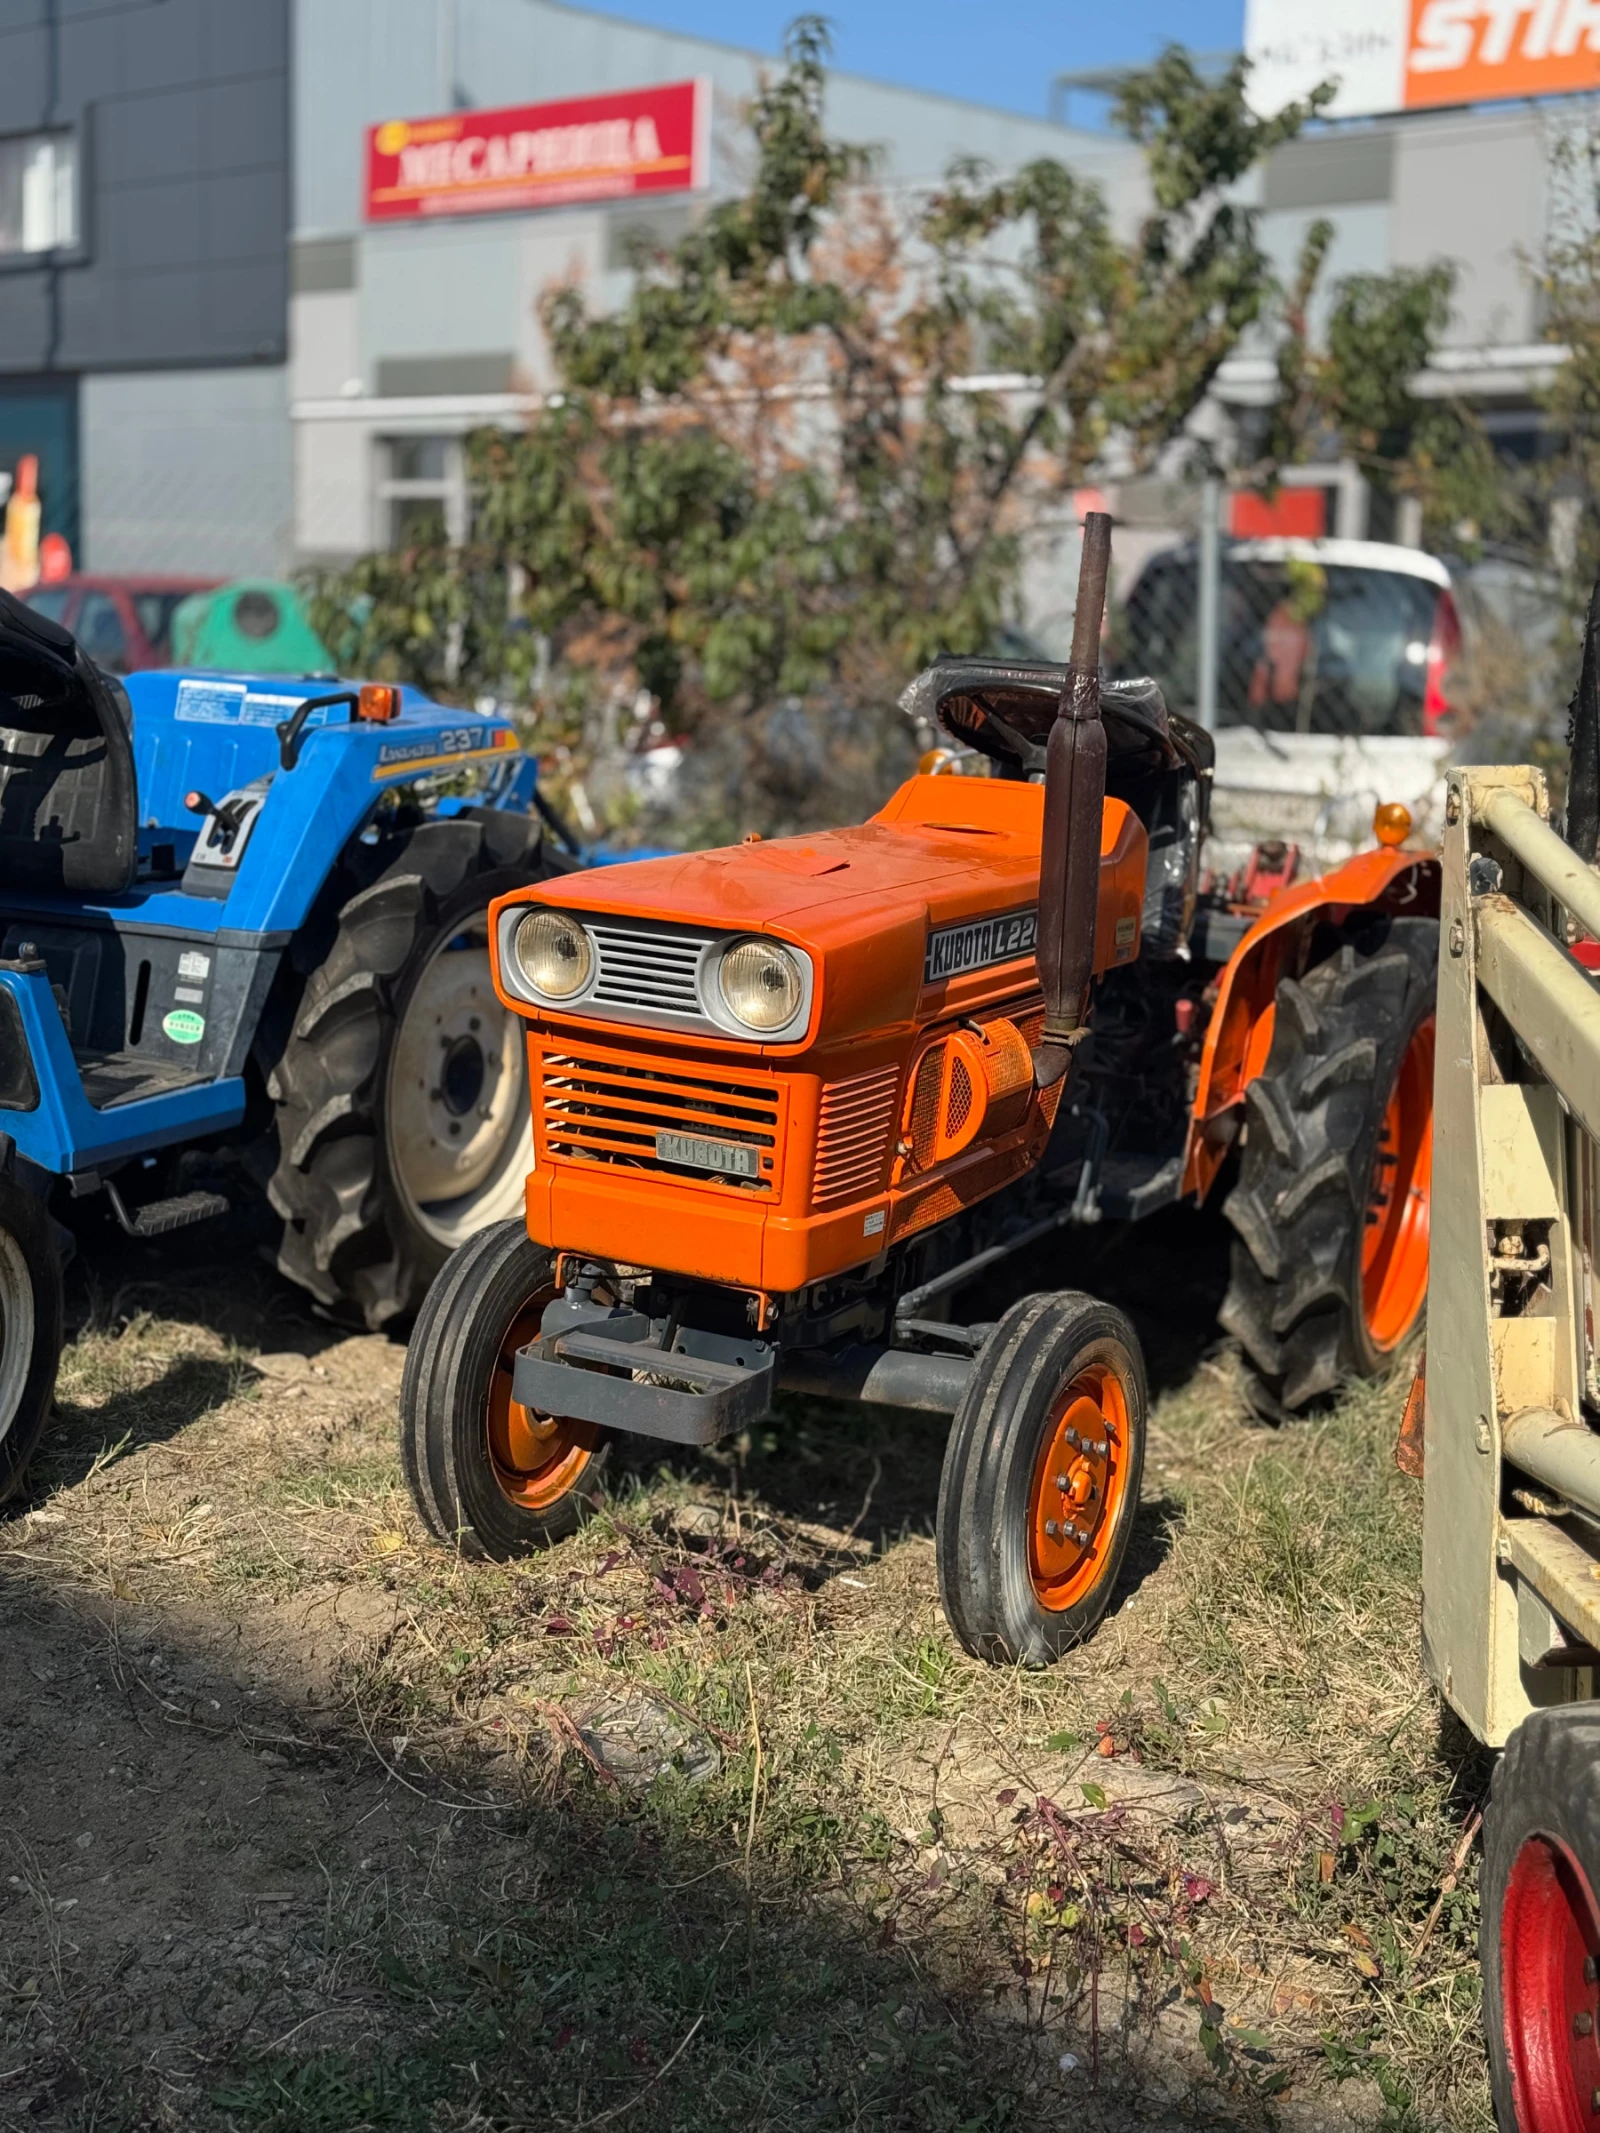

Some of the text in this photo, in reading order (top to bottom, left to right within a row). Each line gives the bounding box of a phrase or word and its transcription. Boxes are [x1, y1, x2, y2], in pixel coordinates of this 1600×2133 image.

[440, 727, 484, 751] 237
[932, 916, 1038, 975] KUBOTA L22
[663, 1134, 749, 1173] KUBOTA
